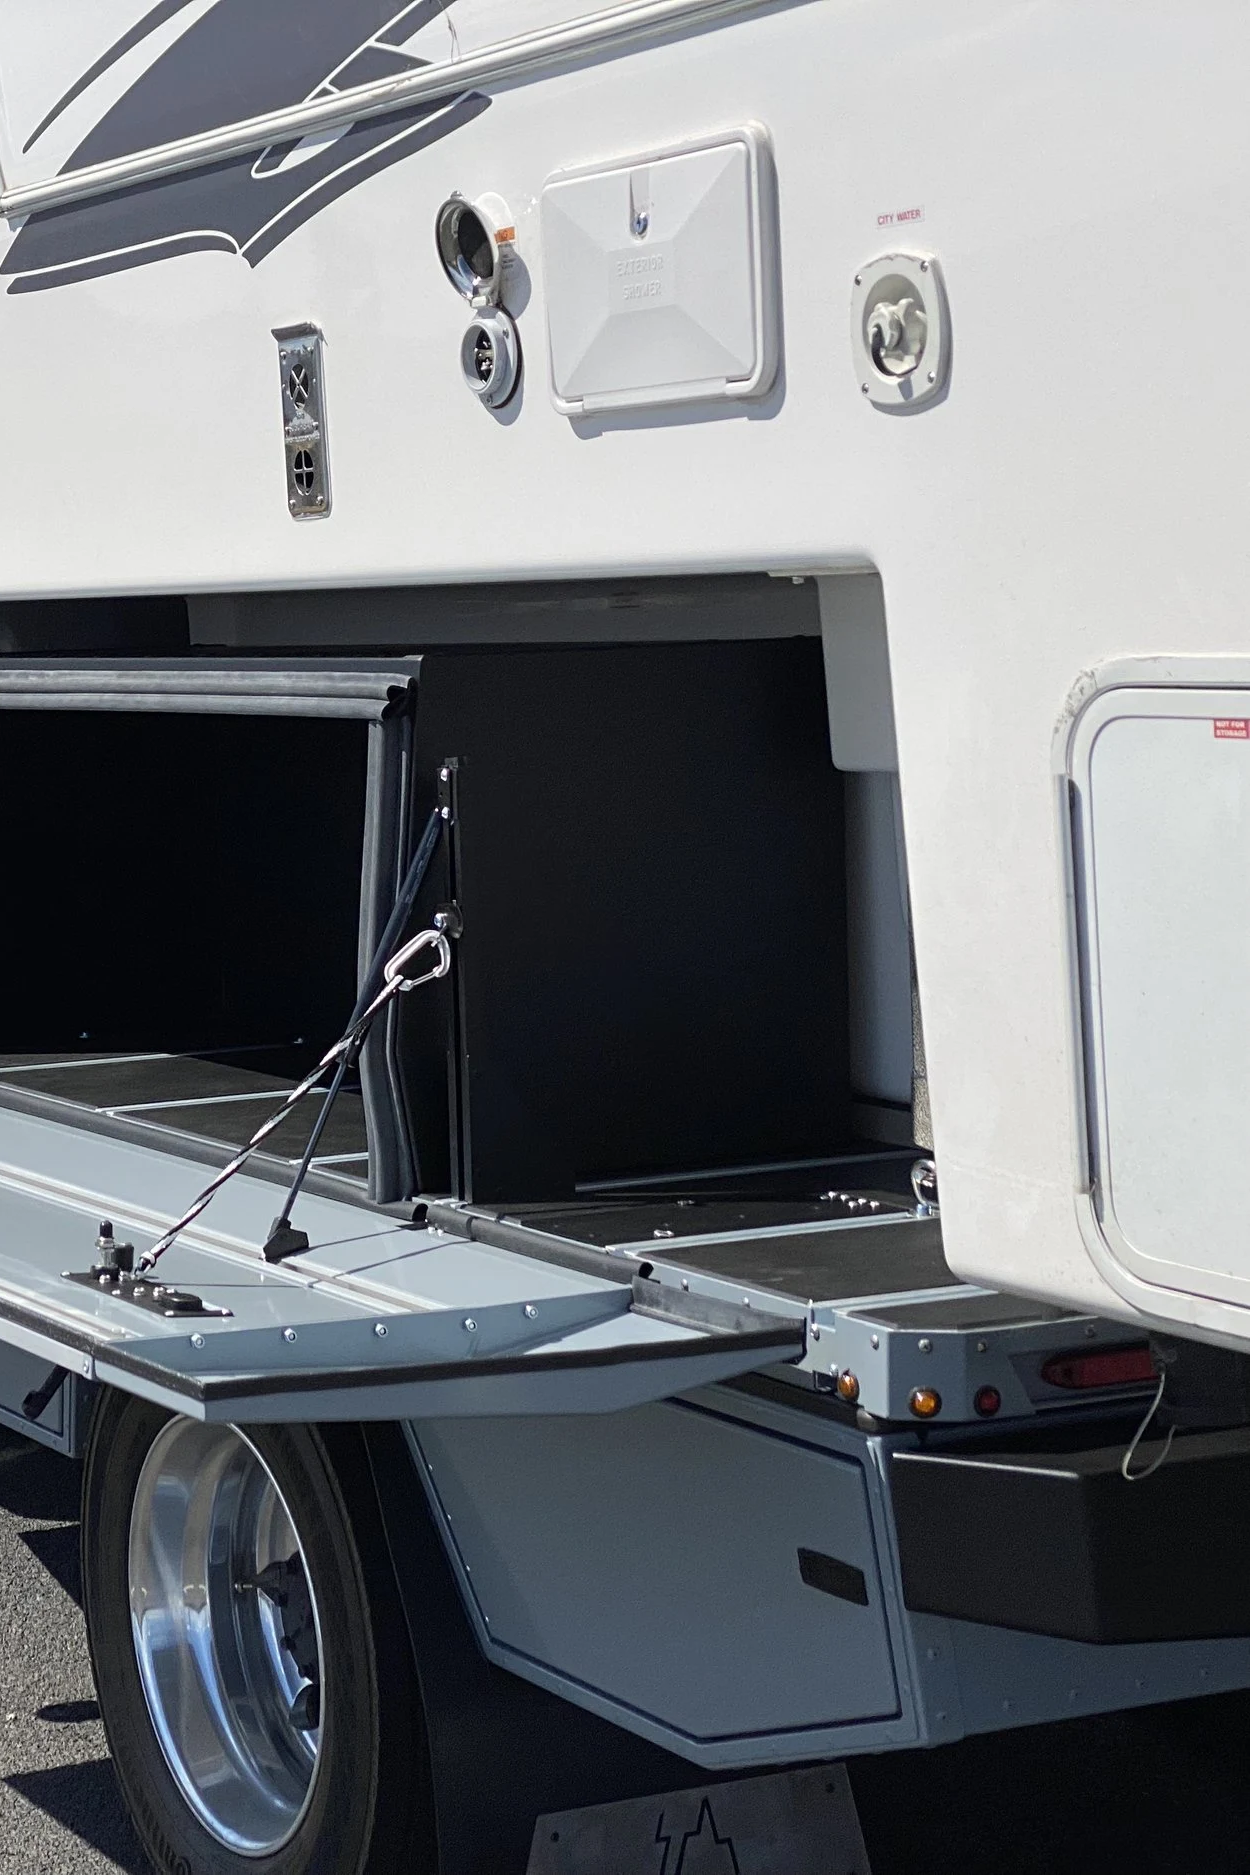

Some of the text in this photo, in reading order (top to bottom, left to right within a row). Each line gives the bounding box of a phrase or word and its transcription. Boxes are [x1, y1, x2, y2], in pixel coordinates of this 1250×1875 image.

[877, 208, 922, 226] CITY WATER
[616, 254, 664, 277] EXTERIOR
[622, 280, 662, 300] SHOWER
